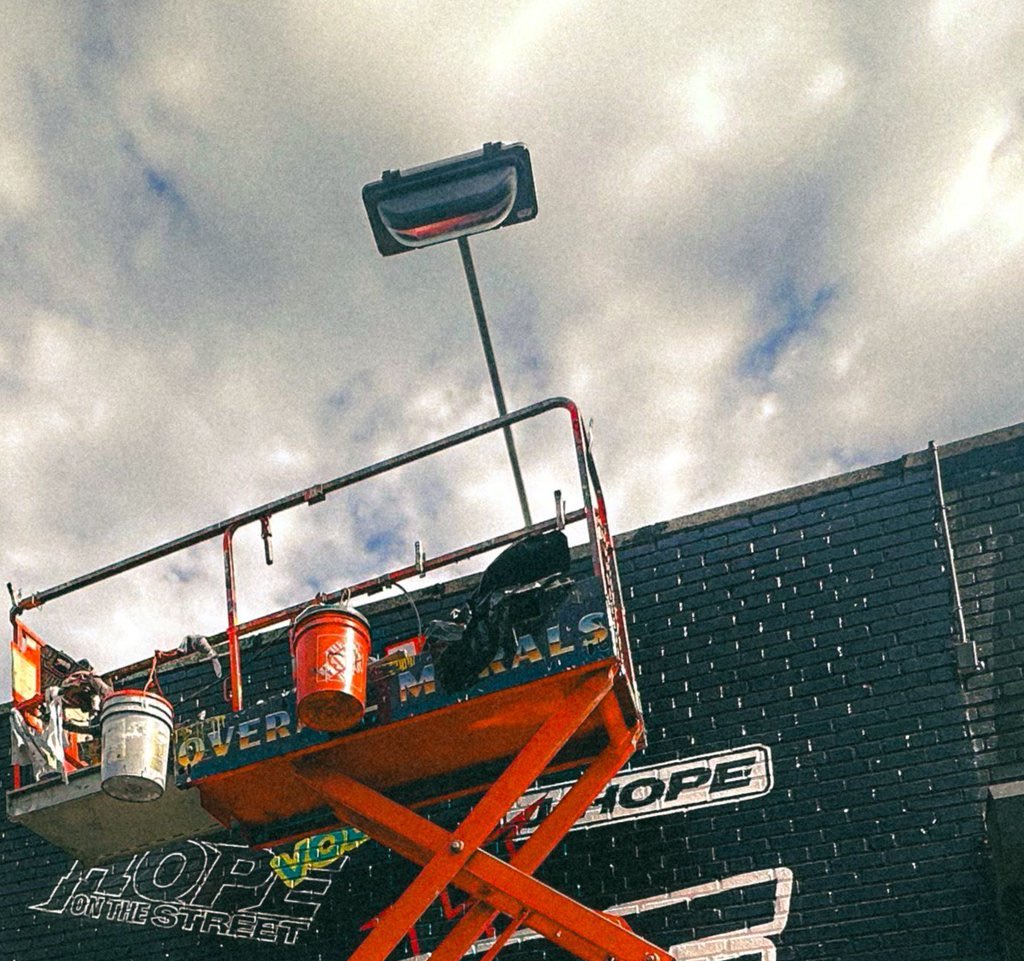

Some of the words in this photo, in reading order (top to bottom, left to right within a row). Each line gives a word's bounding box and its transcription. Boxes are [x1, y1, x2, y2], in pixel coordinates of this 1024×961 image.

[399, 612, 609, 702] MALS
[70, 893, 103, 919] ON
[106, 900, 151, 925] THE
[151, 903, 310, 945] STREET
